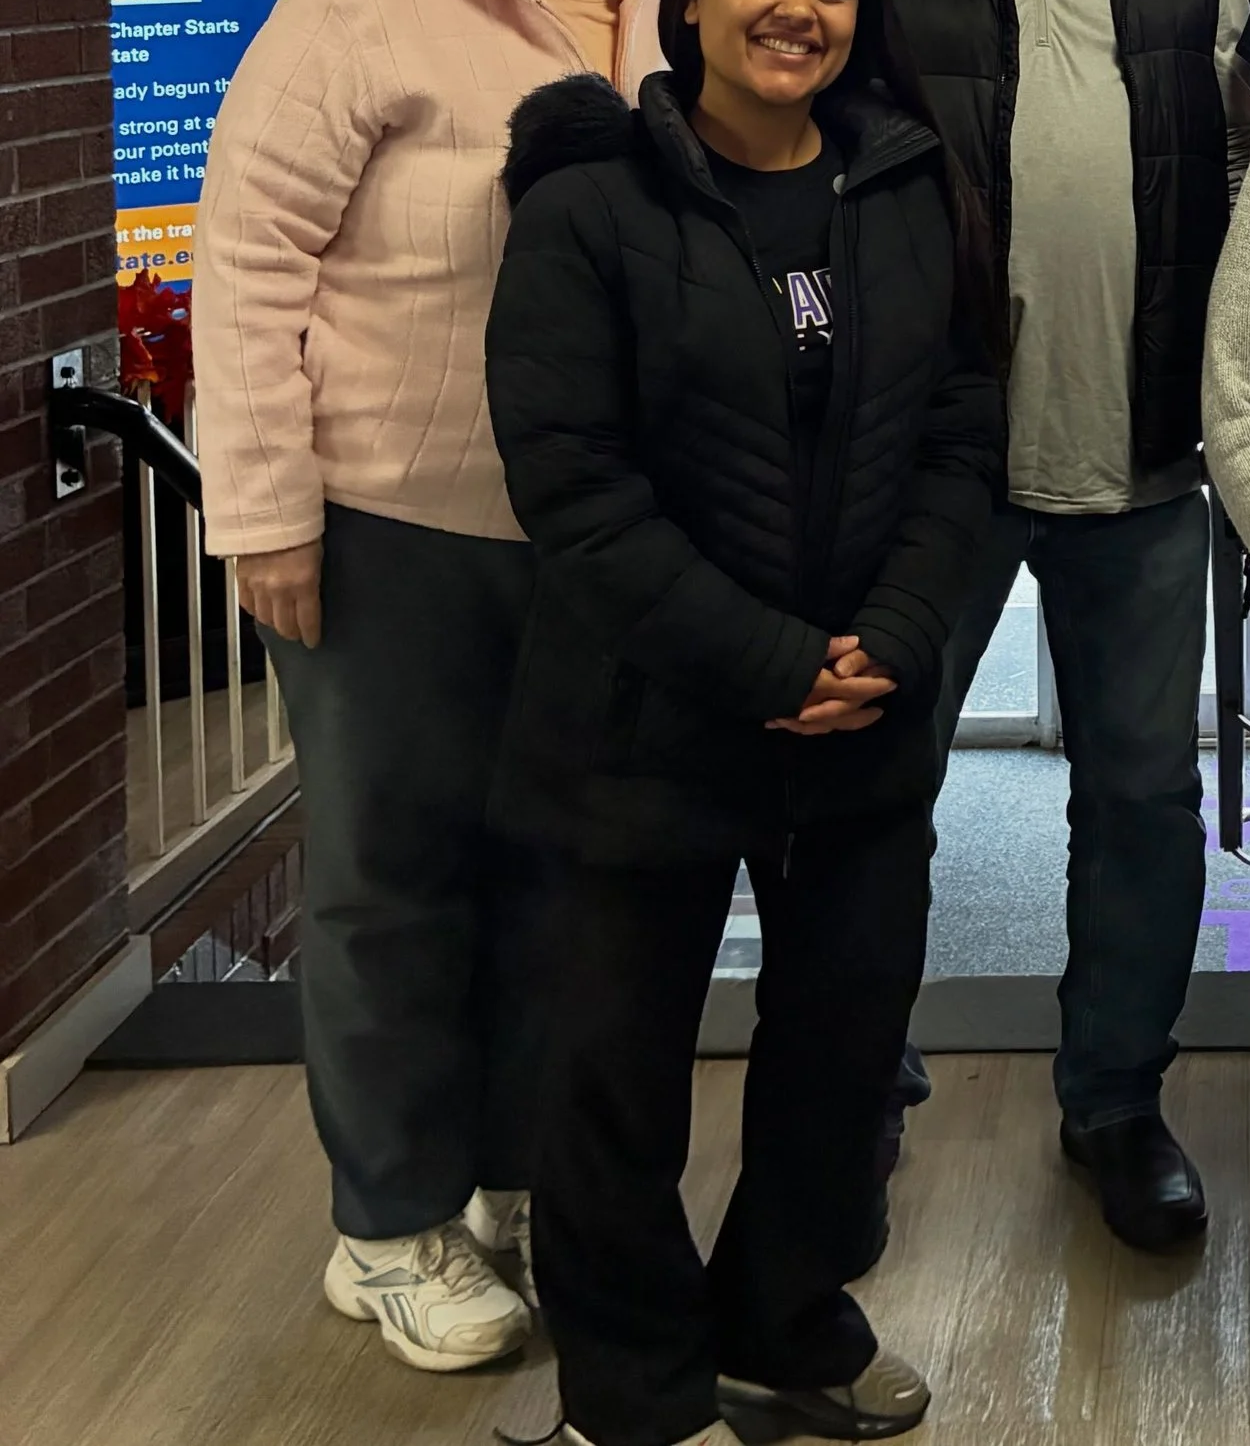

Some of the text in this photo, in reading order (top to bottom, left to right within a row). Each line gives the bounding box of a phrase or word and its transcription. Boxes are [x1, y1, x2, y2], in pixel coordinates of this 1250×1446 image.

[184, 19, 239, 35] Starts
[114, 83, 148, 101] ady
[153, 81, 210, 99] begun
[119, 119, 178, 135] strong
[184, 116, 201, 130] at
[151, 139, 211, 160] potent
[112, 168, 162, 185] make
[167, 165, 179, 180] it
[132, 224, 163, 242] the
[167, 224, 195, 238] tra
[115, 251, 193, 270] tate.e
